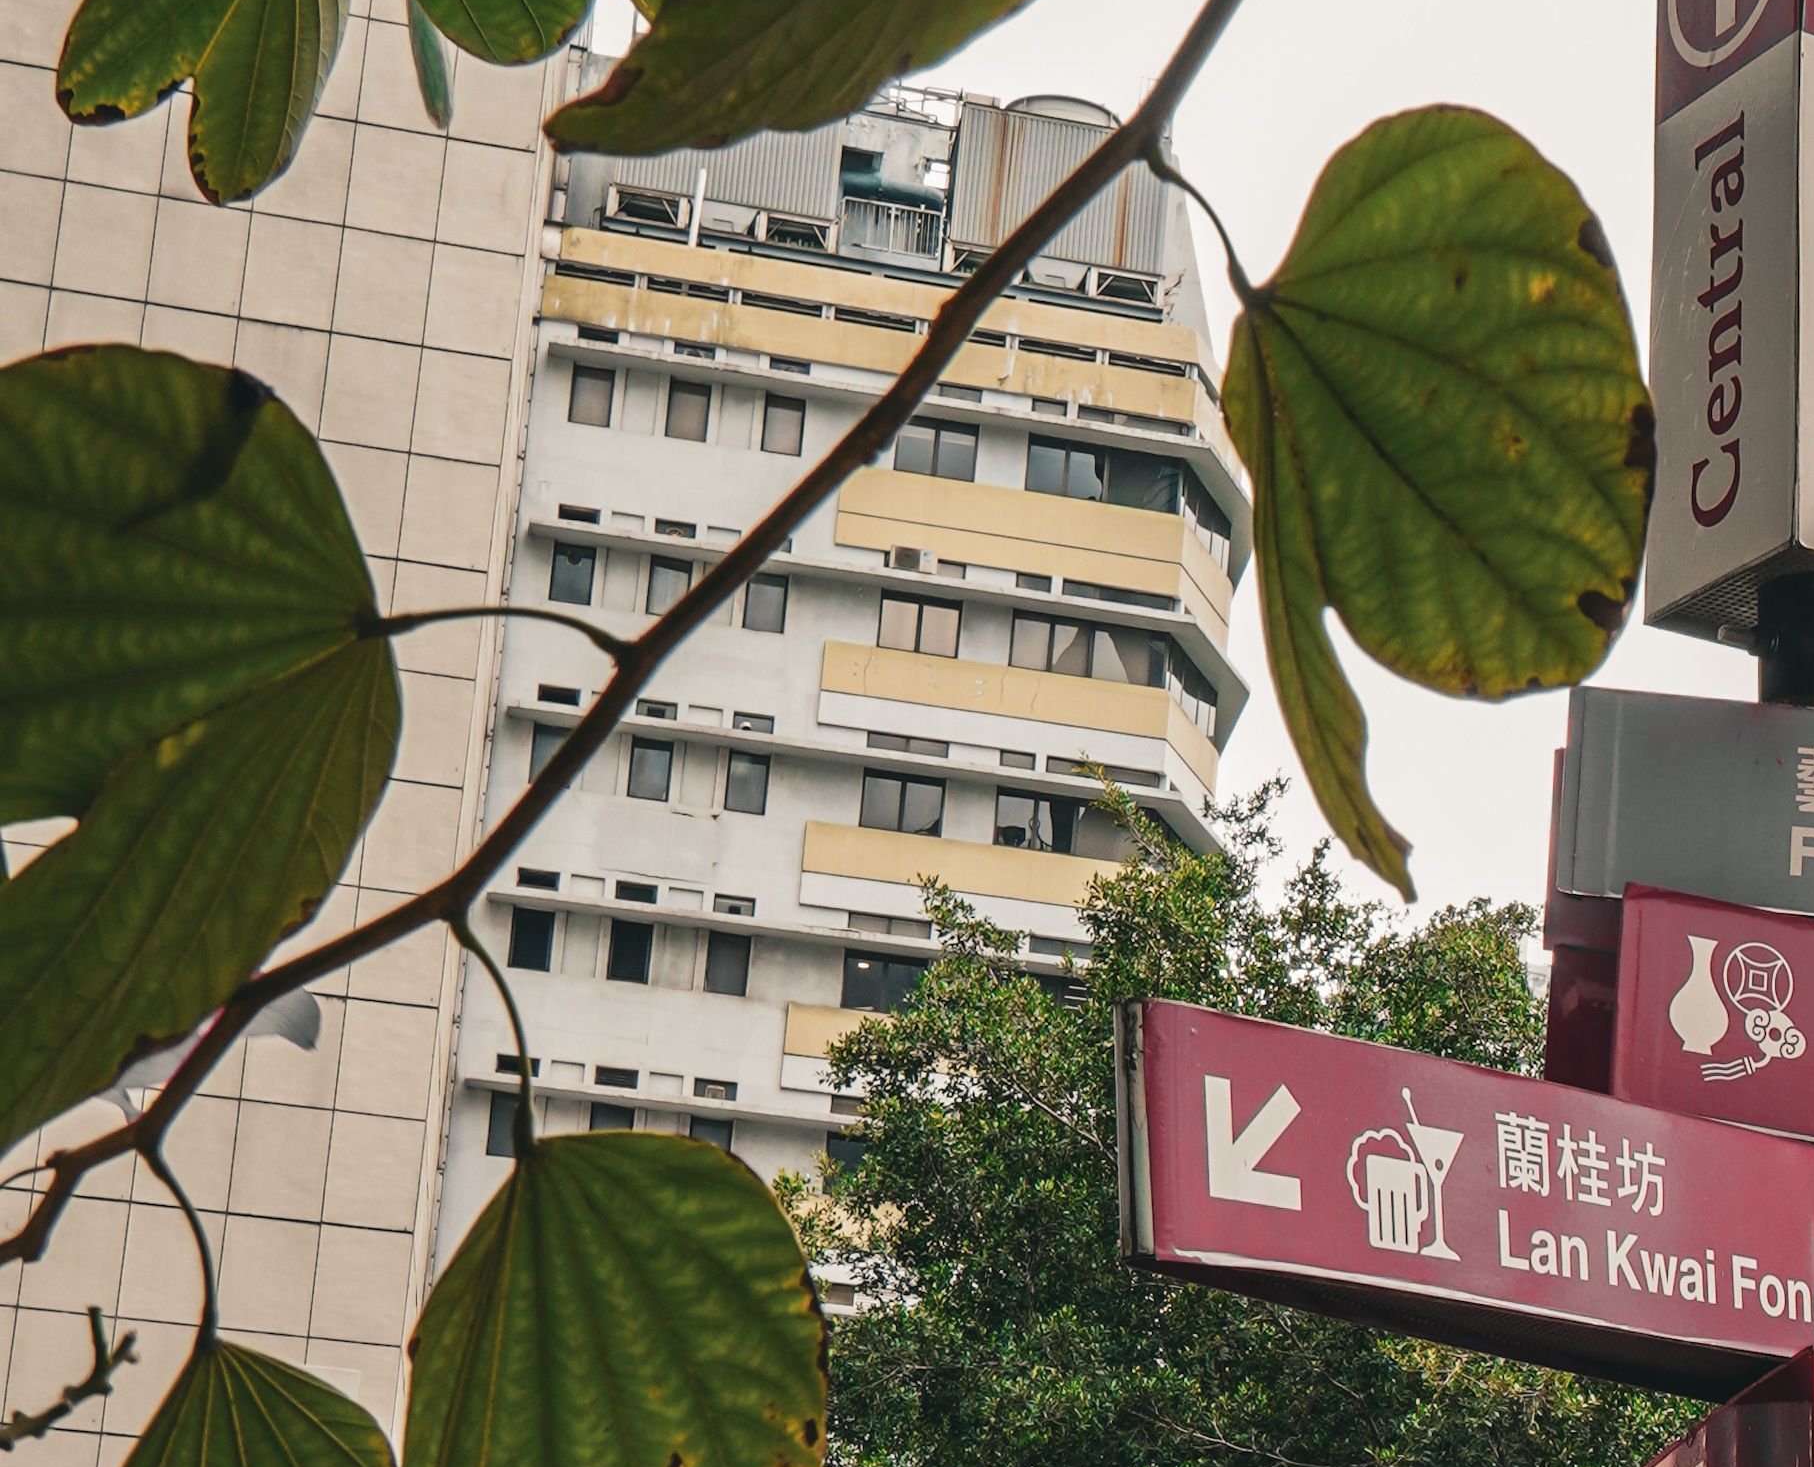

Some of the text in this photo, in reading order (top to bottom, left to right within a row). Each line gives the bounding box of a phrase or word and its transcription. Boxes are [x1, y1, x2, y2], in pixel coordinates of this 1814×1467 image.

[1691, 110, 1746, 528] Central
[1494, 1111, 1666, 1217] 蘭桂坊
[1498, 1209, 1590, 1281] Lan
[1606, 1229, 1717, 1305] Kwai
